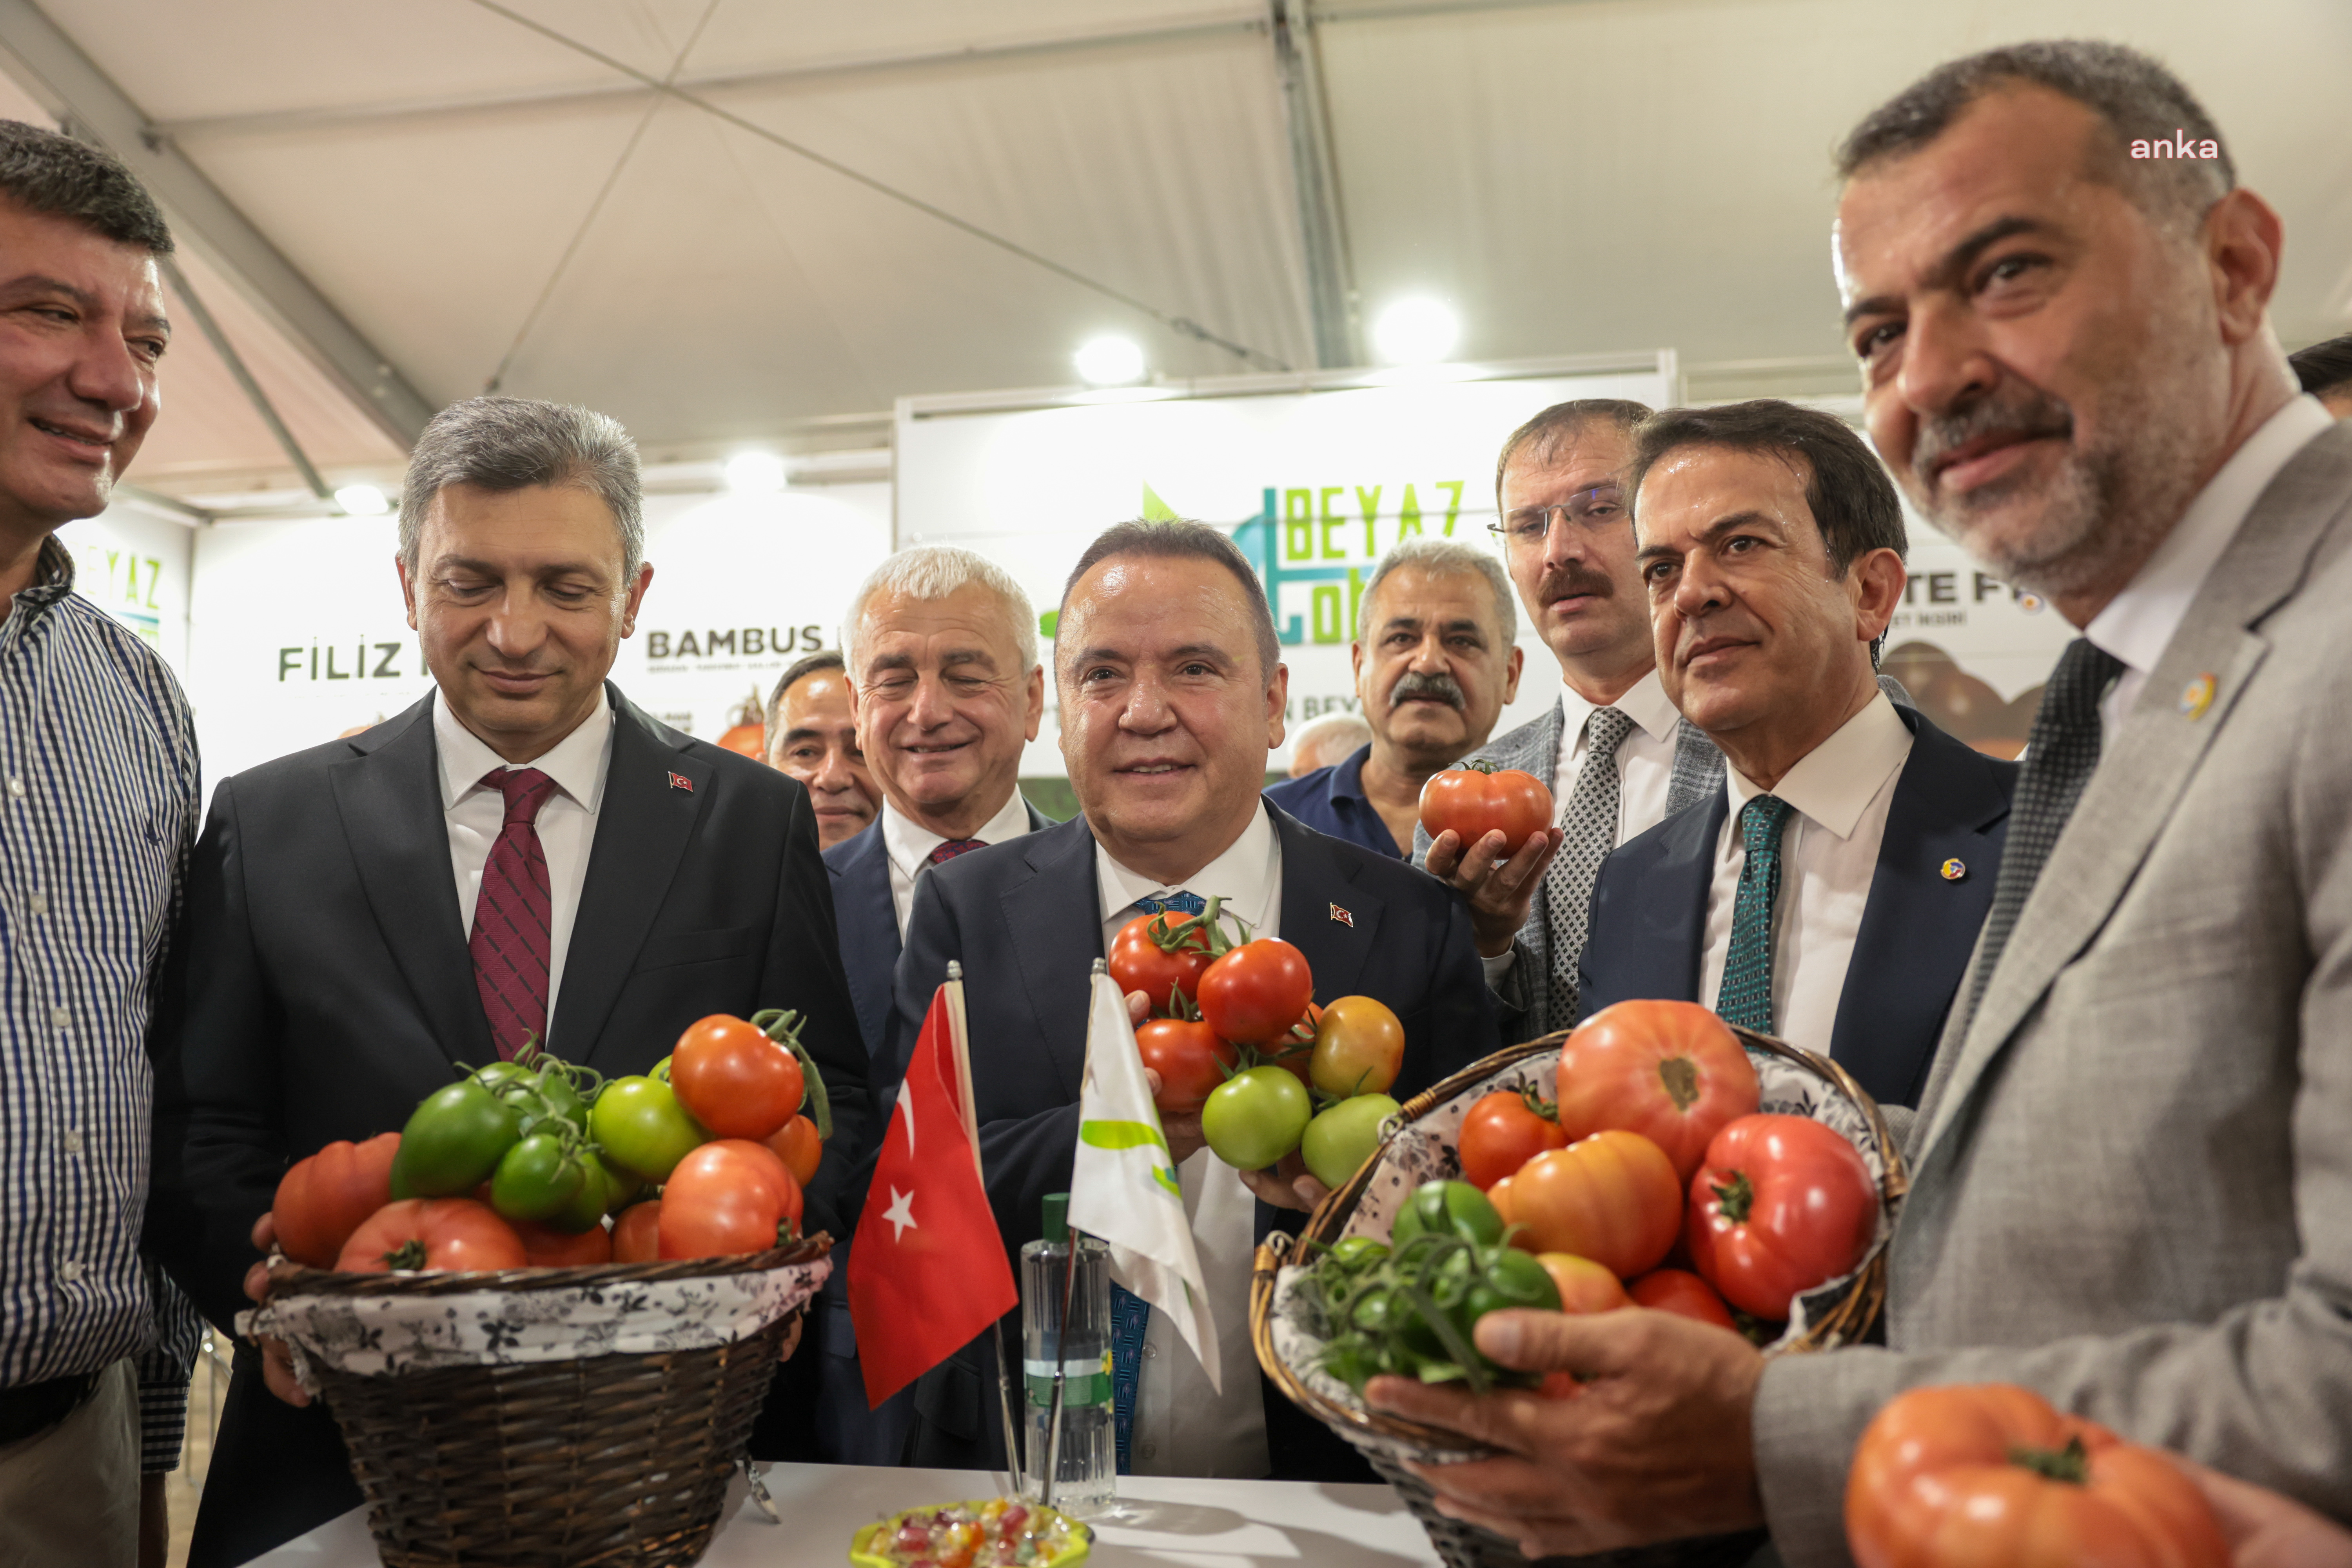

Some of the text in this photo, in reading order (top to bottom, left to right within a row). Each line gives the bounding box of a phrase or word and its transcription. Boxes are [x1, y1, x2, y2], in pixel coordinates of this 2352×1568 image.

[69, 540, 160, 610] EYAZ
[279, 634, 401, 681] FİLİZ
[648, 625, 822, 658] BAMBUS
